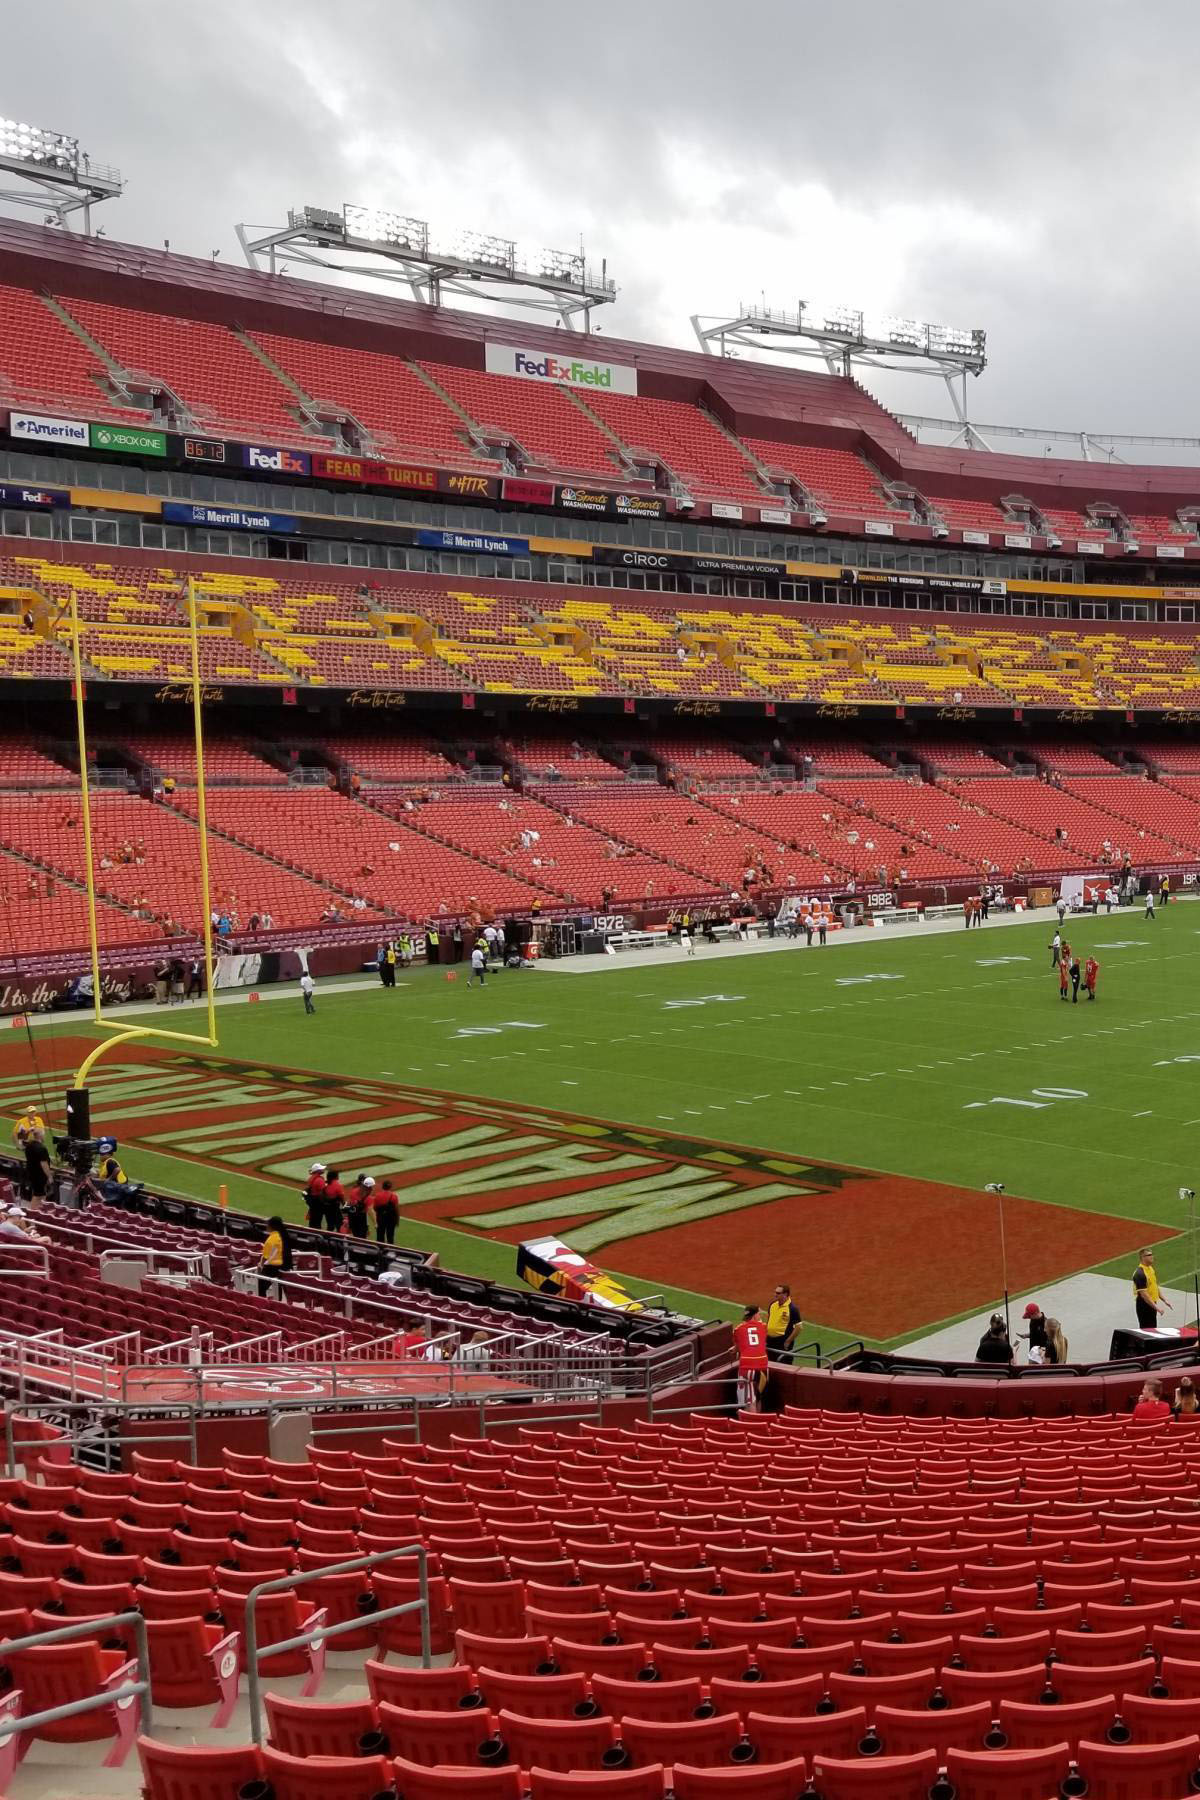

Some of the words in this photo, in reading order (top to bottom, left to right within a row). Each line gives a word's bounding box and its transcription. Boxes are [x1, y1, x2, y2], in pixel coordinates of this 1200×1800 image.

[515, 352, 611, 387] FedExField
[26, 421, 85, 438] Ameritel
[113, 434, 140, 445] XBOX
[141, 437, 161, 449] ONE
[250, 447, 304, 472] FedEx
[22, 491, 52, 504] FedEx
[575, 490, 608, 504] Sports
[630, 496, 661, 510] Sports
[562, 500, 605, 511] WASHINGTON
[617, 507, 659, 517] WASHINGTON
[207, 511, 240, 523] Merrill
[242, 514, 270, 527] Lynch
[455, 536, 482, 548] Merrill
[484, 539, 508, 551] Lynch
[697, 560, 720, 569] ULTRA
[721, 563, 754, 572] PREMIUM
[756, 565, 779, 574] VODKA
[868, 892, 892, 907] 1982
[593, 915, 625, 930] 1972
[989, 1086, 1089, 1110] 10
[747, 1327, 759, 1346] 6
